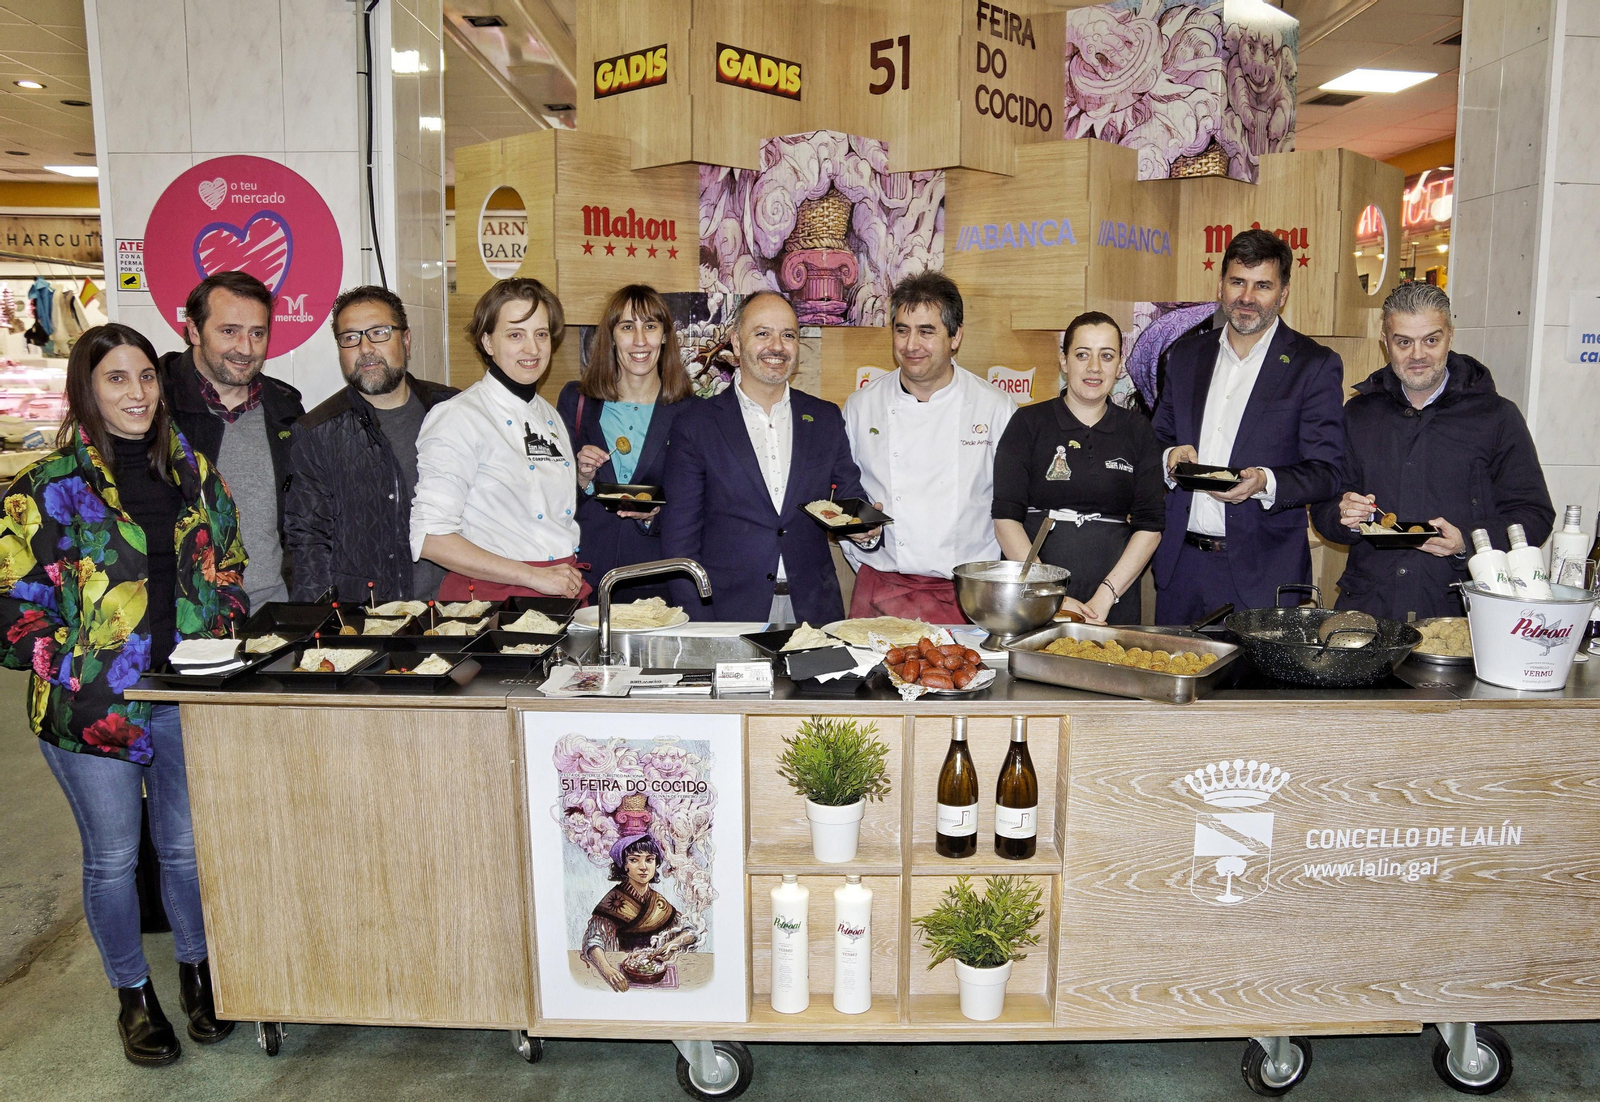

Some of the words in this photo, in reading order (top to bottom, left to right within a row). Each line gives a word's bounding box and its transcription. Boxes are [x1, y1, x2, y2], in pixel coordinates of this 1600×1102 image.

[977, 0, 1036, 50] FEIRA
[595, 48, 667, 93] GADIS
[719, 48, 801, 95] GADIS
[869, 35, 910, 95] 51
[977, 41, 1007, 79] DO
[975, 84, 1052, 132] COCIDO
[230, 182, 238, 191] o
[240, 181, 258, 191] teu
[231, 192, 286, 204] mercado
[483, 222, 528, 236] ARN
[581, 205, 677, 242] Mahou
[964, 218, 1077, 251] ABANCA
[1103, 219, 1172, 256] ABANCA
[275, 312, 314, 322] mercado
[1510, 617, 1574, 639] Petroni
[562, 779, 575, 791] 51
[580, 779, 621, 791] FEIRA
[626, 780, 647, 792] DO
[652, 780, 708, 792] COCIDO
[1305, 828, 1420, 850] CONCELLO
[1426, 827, 1455, 848] DE
[1460, 820, 1522, 847] LALÍN
[1303, 857, 1439, 882] www.lalin.gal
